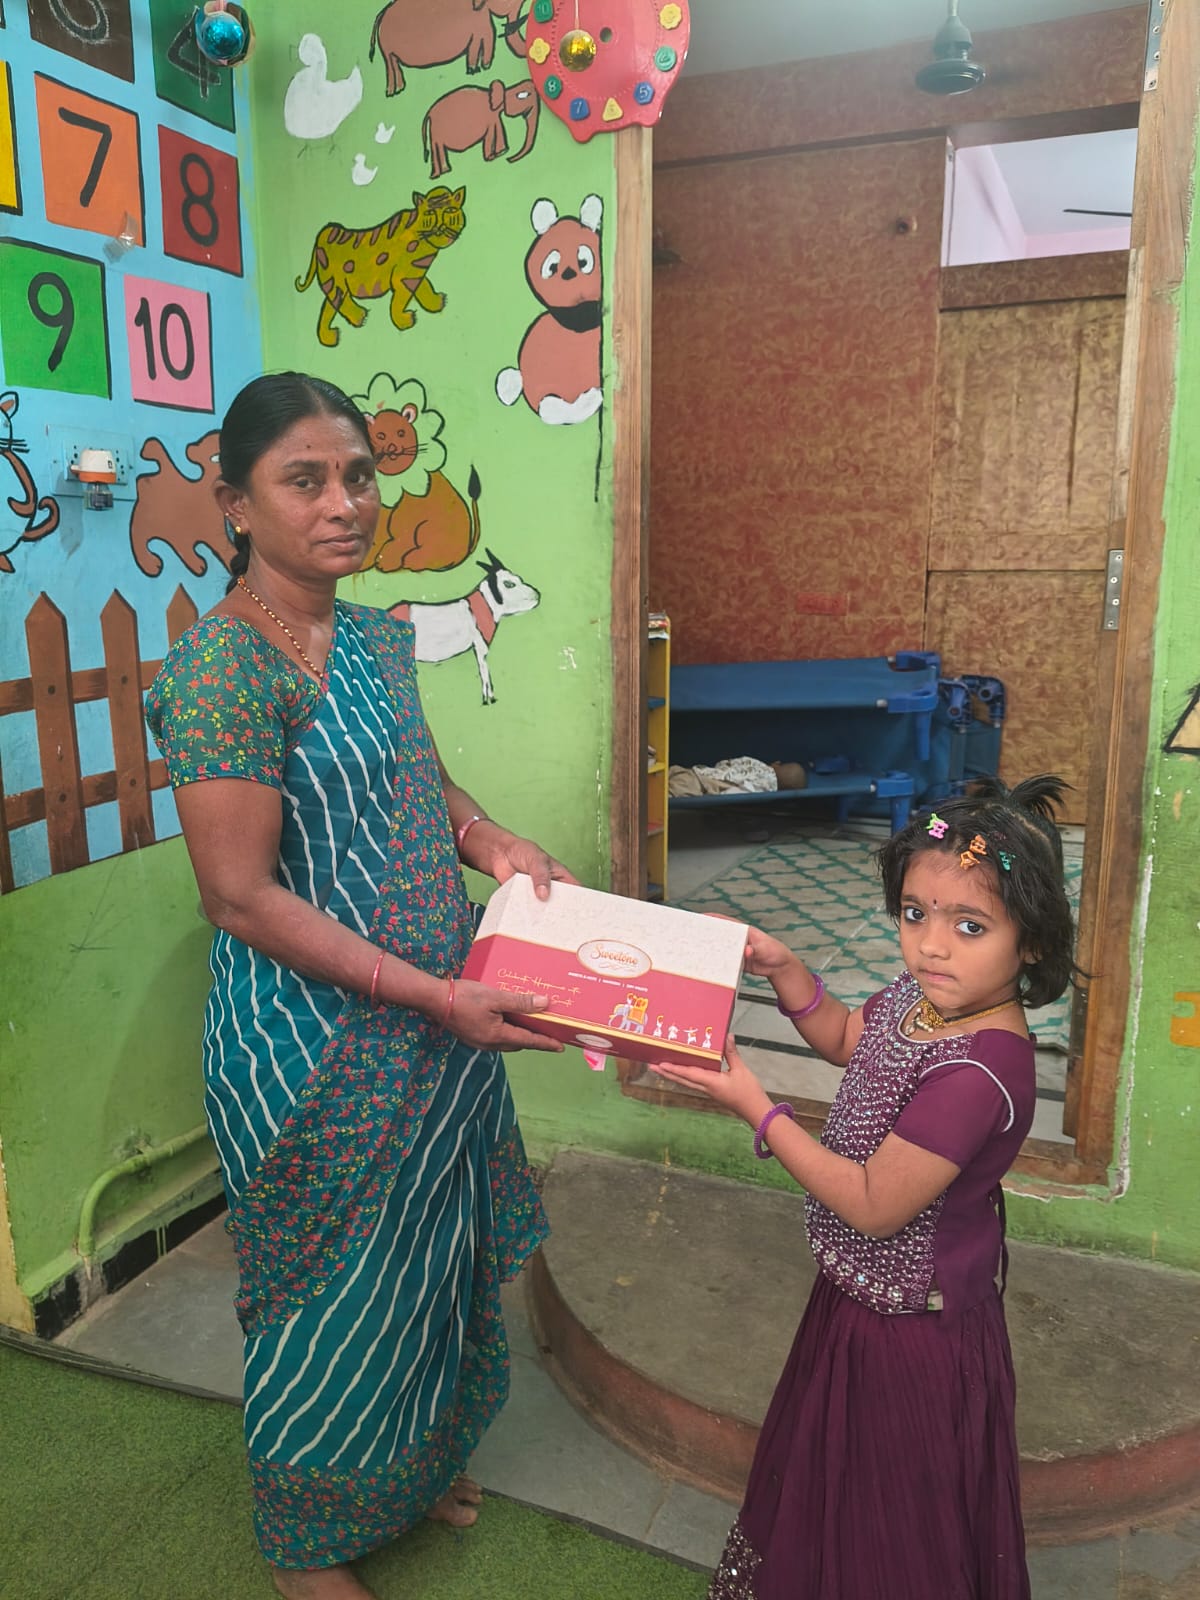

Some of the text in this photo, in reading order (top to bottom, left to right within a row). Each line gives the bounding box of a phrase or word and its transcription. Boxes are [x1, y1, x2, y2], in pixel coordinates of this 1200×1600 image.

[547, 80, 557, 93] 8
[639, 86, 649, 99] 5
[58, 106, 112, 207] 7
[179, 152, 219, 247] 8
[27, 271, 75, 372] 9
[134, 296, 195, 381] 10
